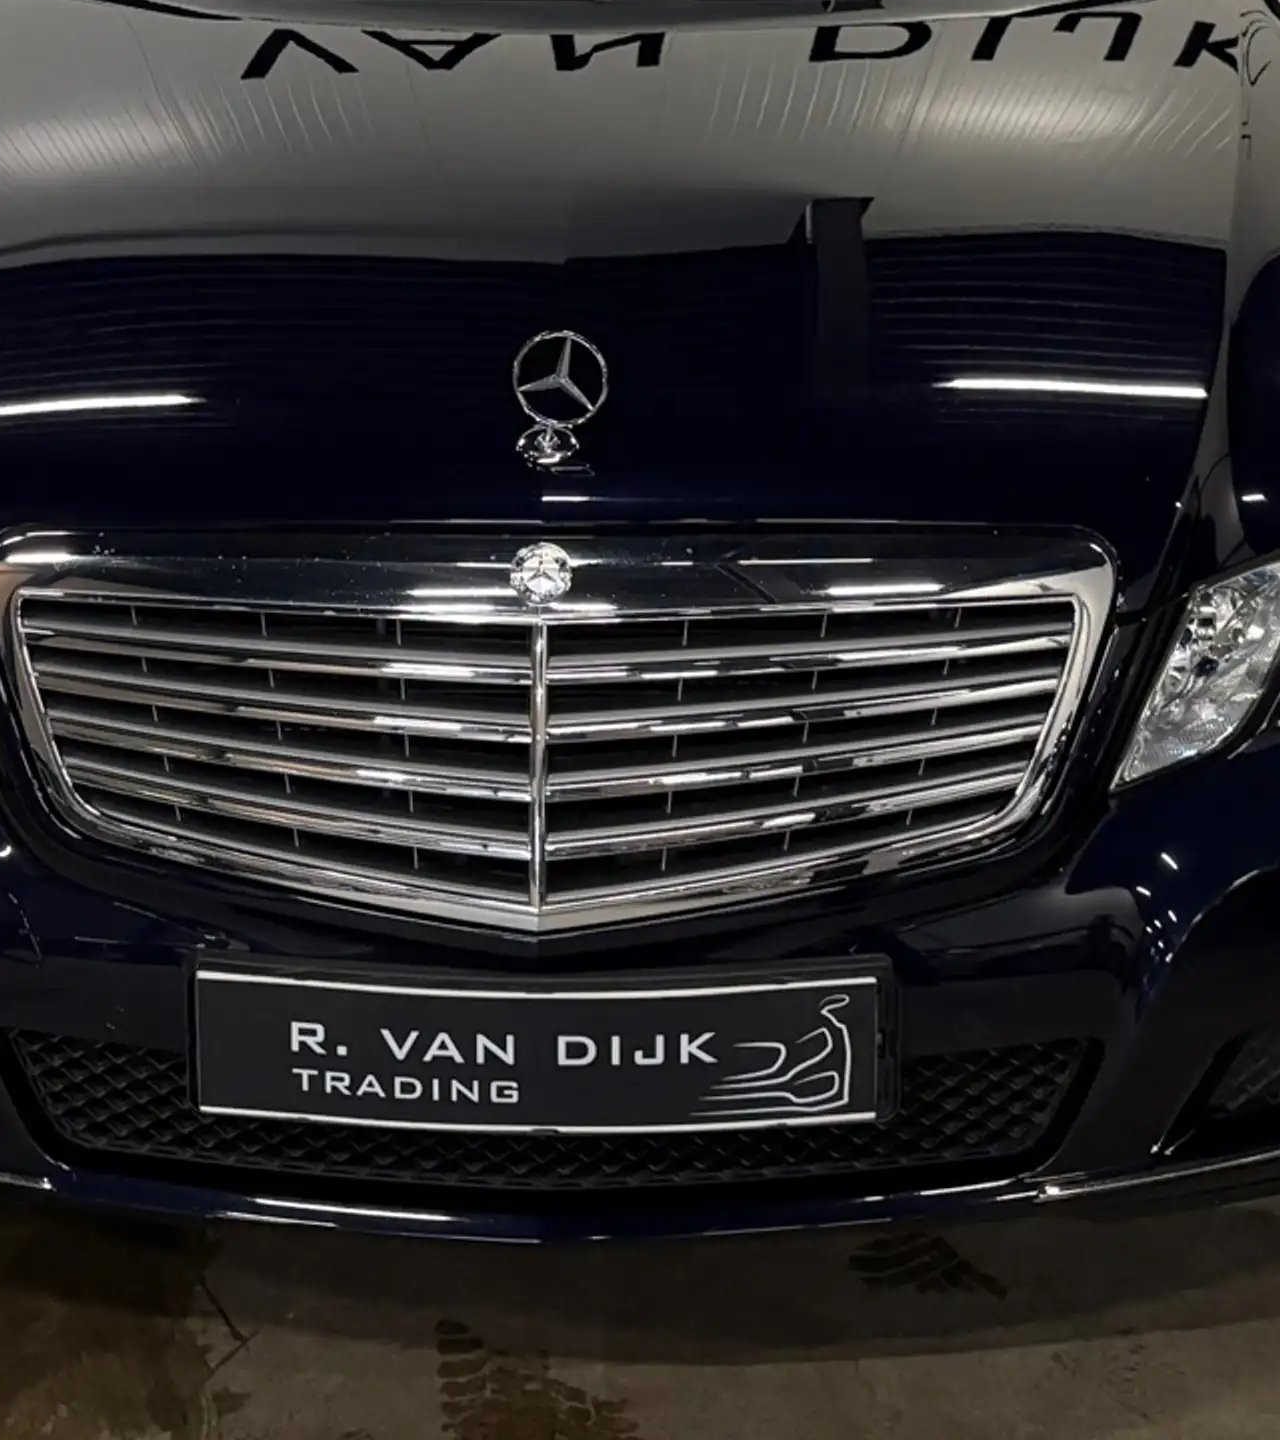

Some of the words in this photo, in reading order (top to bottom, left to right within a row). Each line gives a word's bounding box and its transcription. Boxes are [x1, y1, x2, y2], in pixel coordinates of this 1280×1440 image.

[290, 1020, 348, 1057] R.
[379, 1027, 516, 1066] VAN
[556, 1031, 718, 1067] DIJK
[291, 1067, 520, 1104] TRADING
